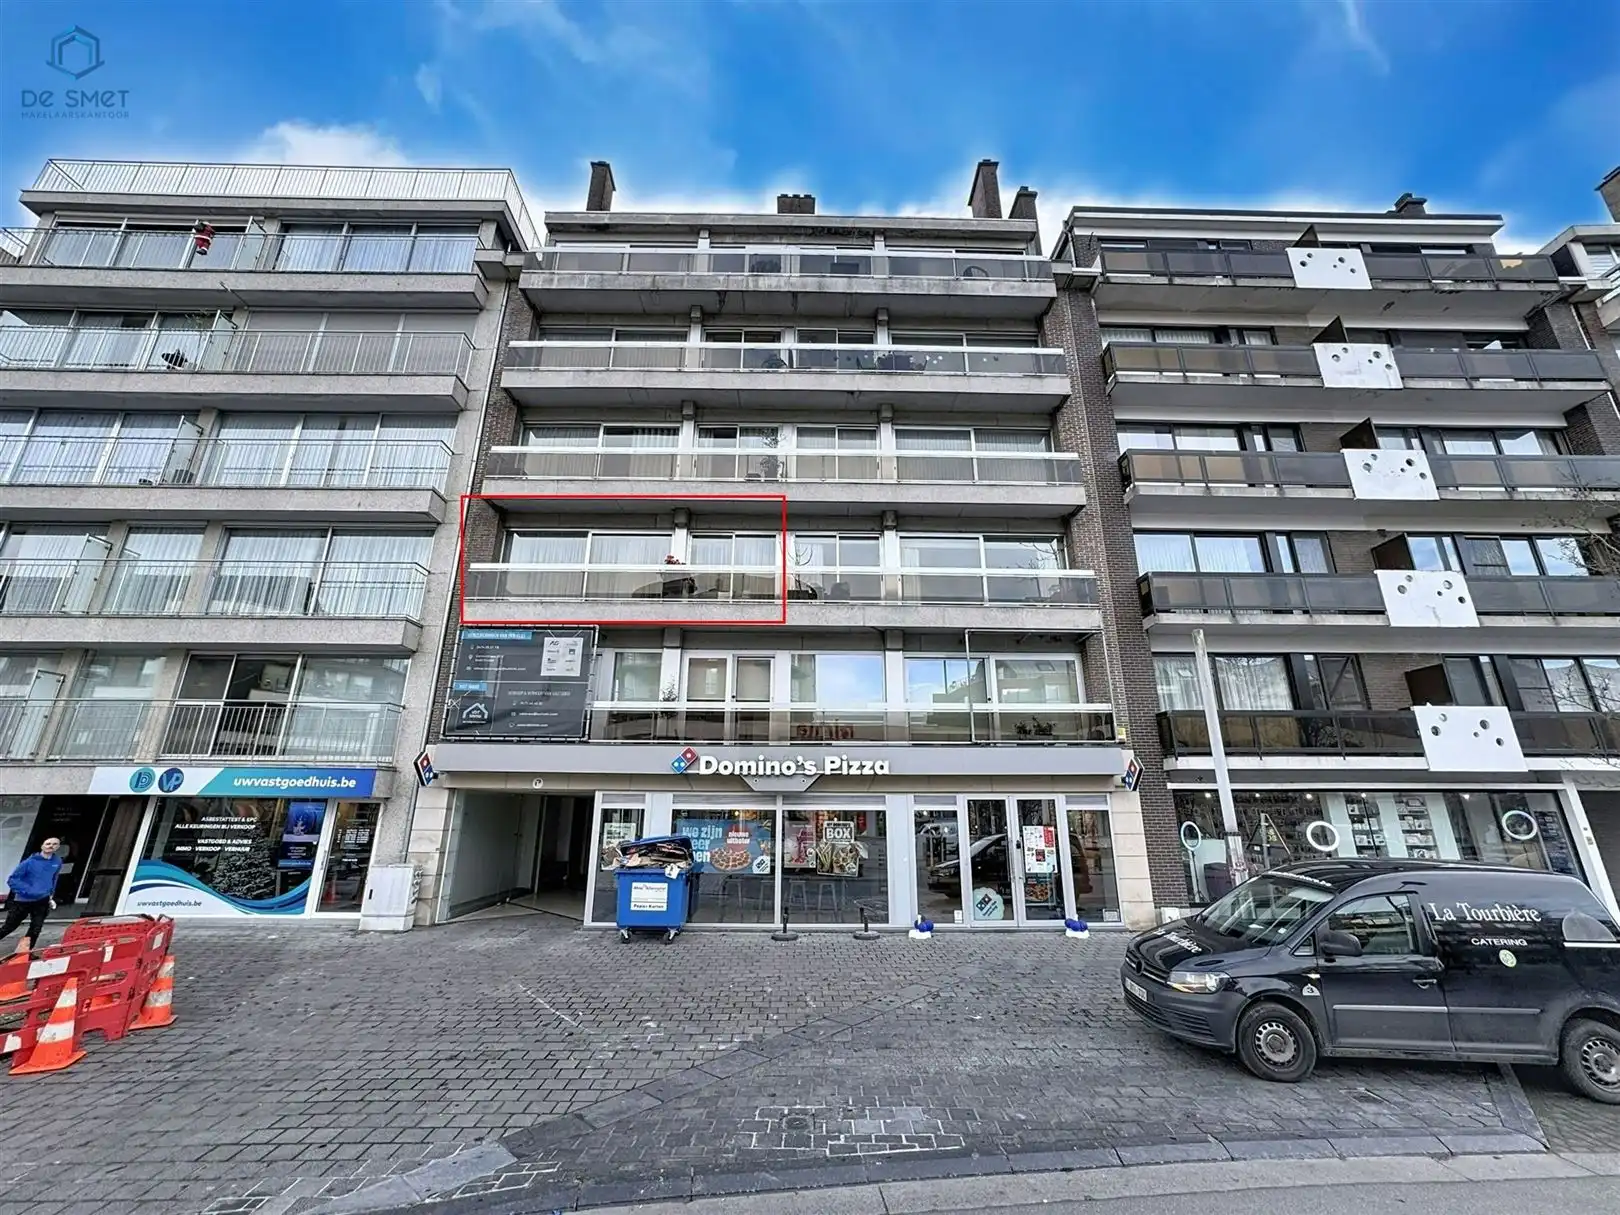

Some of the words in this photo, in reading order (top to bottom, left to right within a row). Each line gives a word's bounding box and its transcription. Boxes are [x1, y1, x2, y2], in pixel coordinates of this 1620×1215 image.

[699, 754, 817, 775] Domino's
[824, 754, 890, 775] Pizza
[233, 776, 357, 789] uwvastgoedhuis.be
[682, 827, 699, 837] we
[700, 824, 723, 840] zijn
[826, 827, 851, 839] BOX
[692, 839, 711, 850] eer
[137, 899, 202, 908] uwvastgoedhuis.be
[1428, 902, 1456, 922] La
[1456, 902, 1542, 922] Tourbière
[1471, 938, 1528, 947] CATERING
